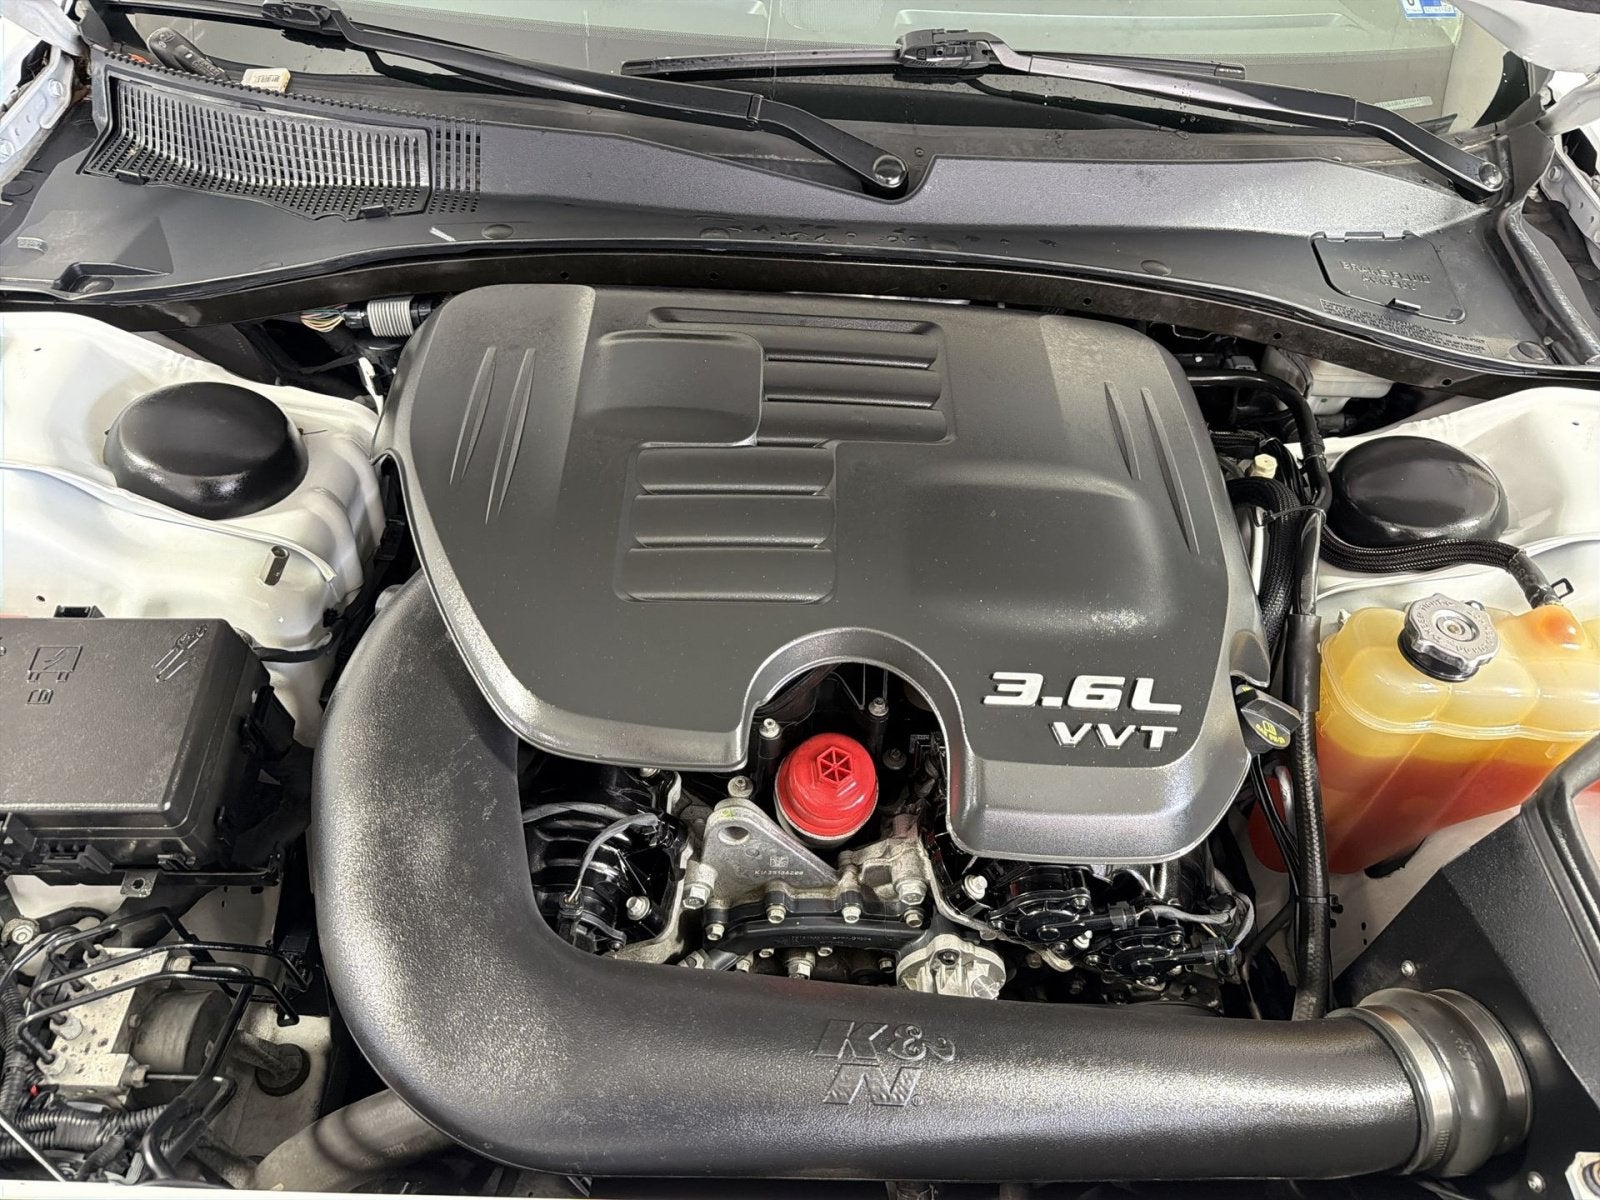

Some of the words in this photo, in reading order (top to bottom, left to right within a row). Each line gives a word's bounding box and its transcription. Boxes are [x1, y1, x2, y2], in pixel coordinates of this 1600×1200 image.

[1340, 260, 1390, 278] BRAKE
[1389, 270, 1431, 284] FLUID
[982, 671, 1182, 715] 3.6L
[1049, 721, 1179, 751] VVT
